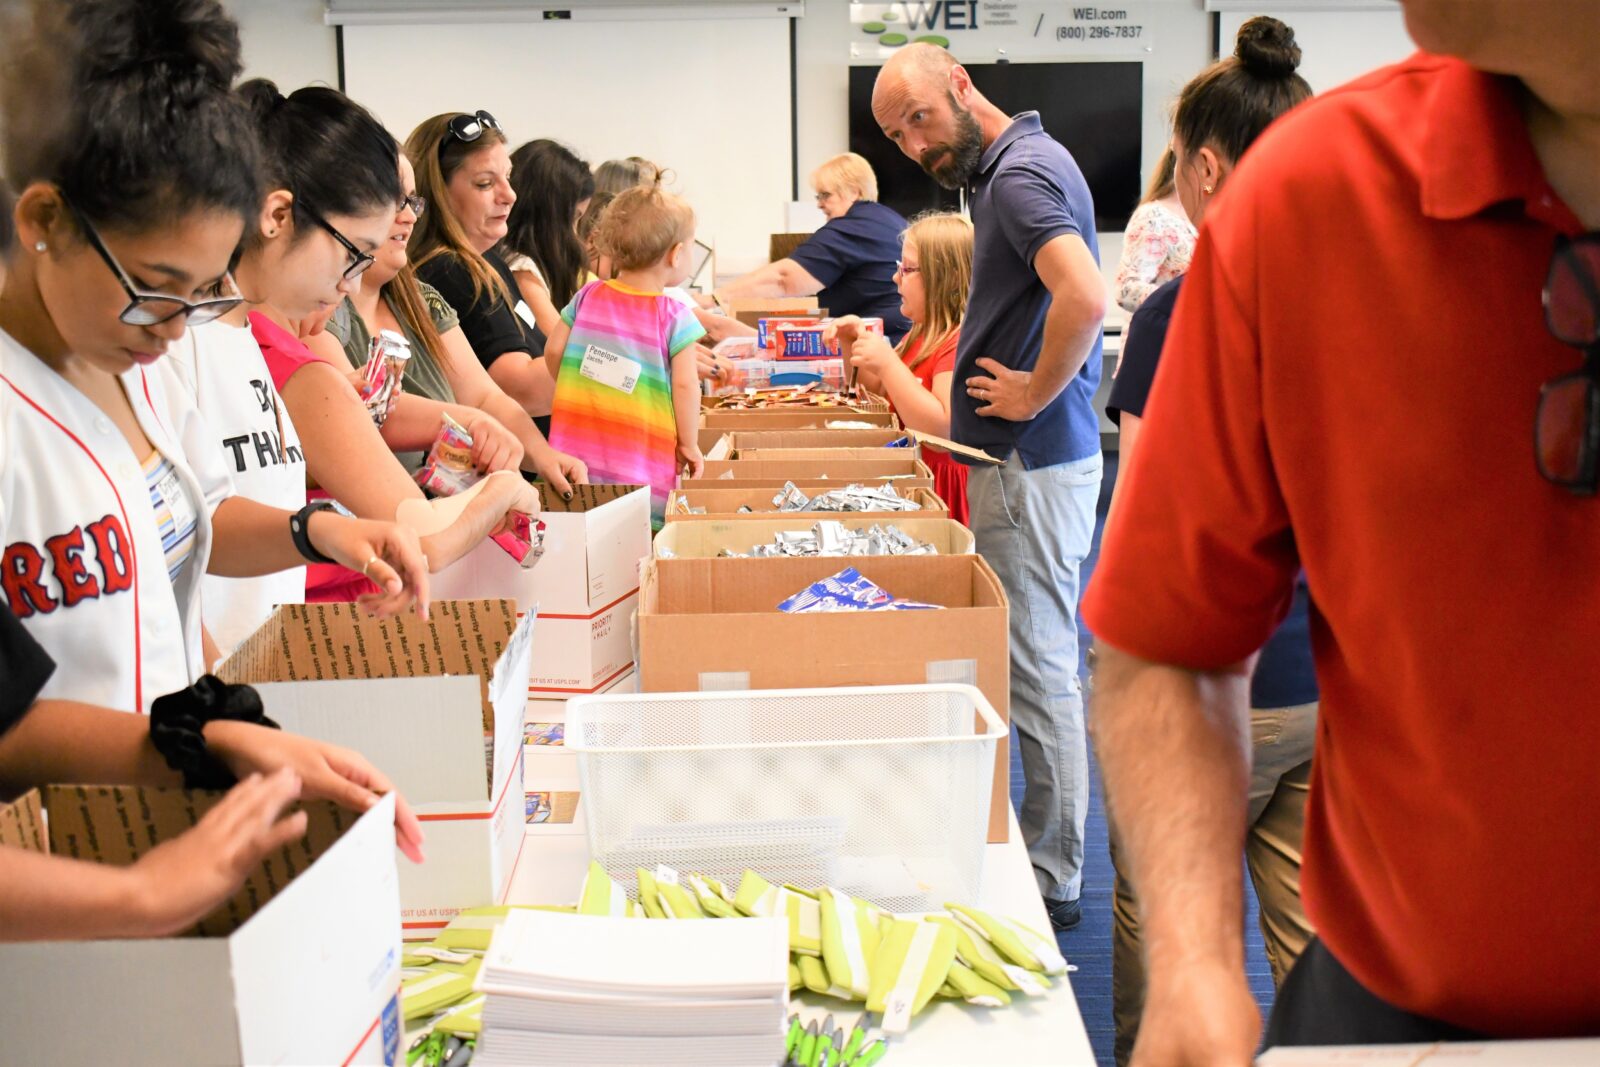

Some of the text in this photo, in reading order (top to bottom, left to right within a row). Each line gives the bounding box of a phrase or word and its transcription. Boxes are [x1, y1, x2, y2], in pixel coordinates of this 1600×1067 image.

[904, 0, 978, 30] WEI
[1073, 8, 1127, 20] WEI.com
[1056, 26, 1143, 42] (800) 296-7837
[589, 345, 619, 363] Penelope
[0, 514, 134, 618] RED
[300, 604, 310, 625] hank
[317, 605, 329, 636] Priority
[451, 601, 461, 622] hank
[467, 602, 480, 633] Priority
[454, 623, 464, 638] you
[592, 613, 613, 632] PRIORITY
[304, 626, 314, 642] you
[353, 625, 367, 658] postage
[379, 625, 389, 640] you
[385, 641, 393, 654] for
[428, 622, 442, 656] postage
[310, 643, 318, 656] for
[418, 643, 431, 674] Priority
[343, 645, 355, 676] Priority
[401, 909, 414, 917] ISIT
[416, 909, 427, 917] US
[428, 908, 438, 916] AT
